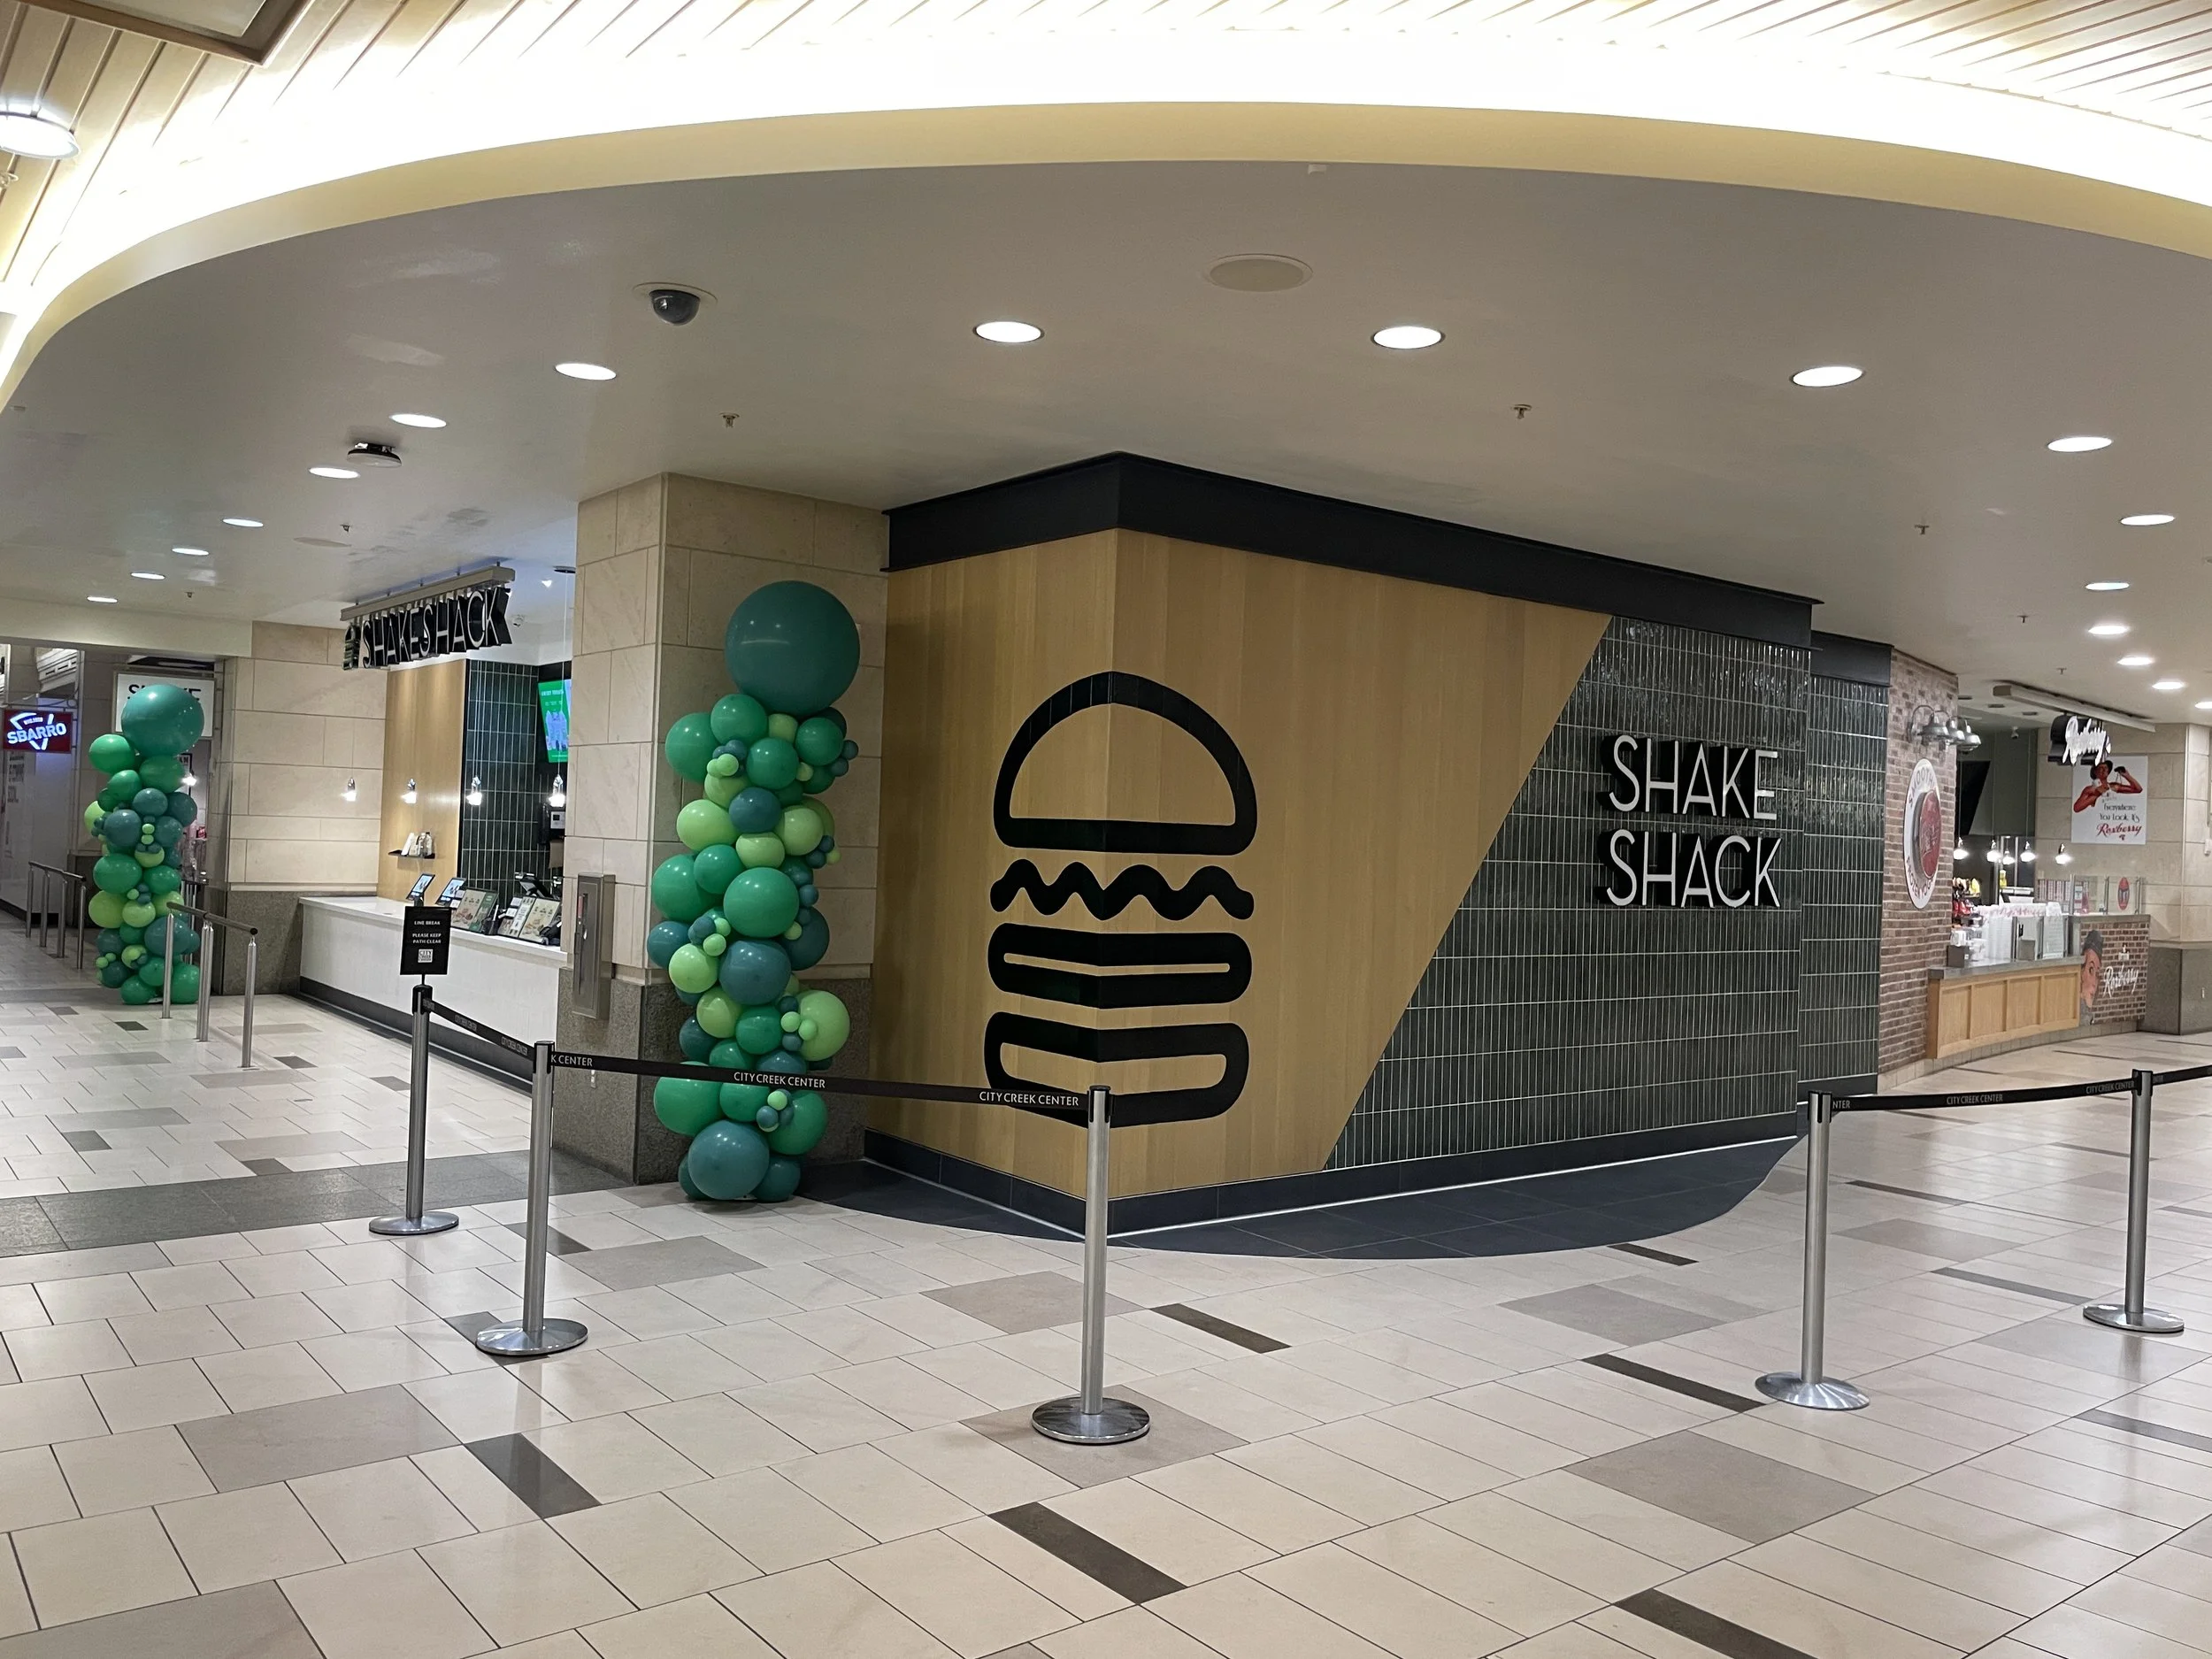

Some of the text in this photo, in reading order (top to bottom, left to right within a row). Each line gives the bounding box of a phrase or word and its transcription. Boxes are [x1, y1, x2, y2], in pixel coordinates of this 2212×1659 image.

[7, 723, 67, 744] SBARRO
[1609, 734, 1778, 821] SHAKE
[2096, 822, 2143, 838] Roxberry
[1606, 829, 1783, 909] SHACK
[558, 1055, 593, 1067] CENTER
[733, 1071, 826, 1088] CITY CREEK CENTER
[2085, 1080, 2135, 1094] CITY CREEK CENTER
[979, 1091, 1079, 1106] CITY CREEK CENTER
[1832, 1100, 1851, 1110] NTER
[1947, 1094, 2003, 1105] CITY CREEK CENTER
